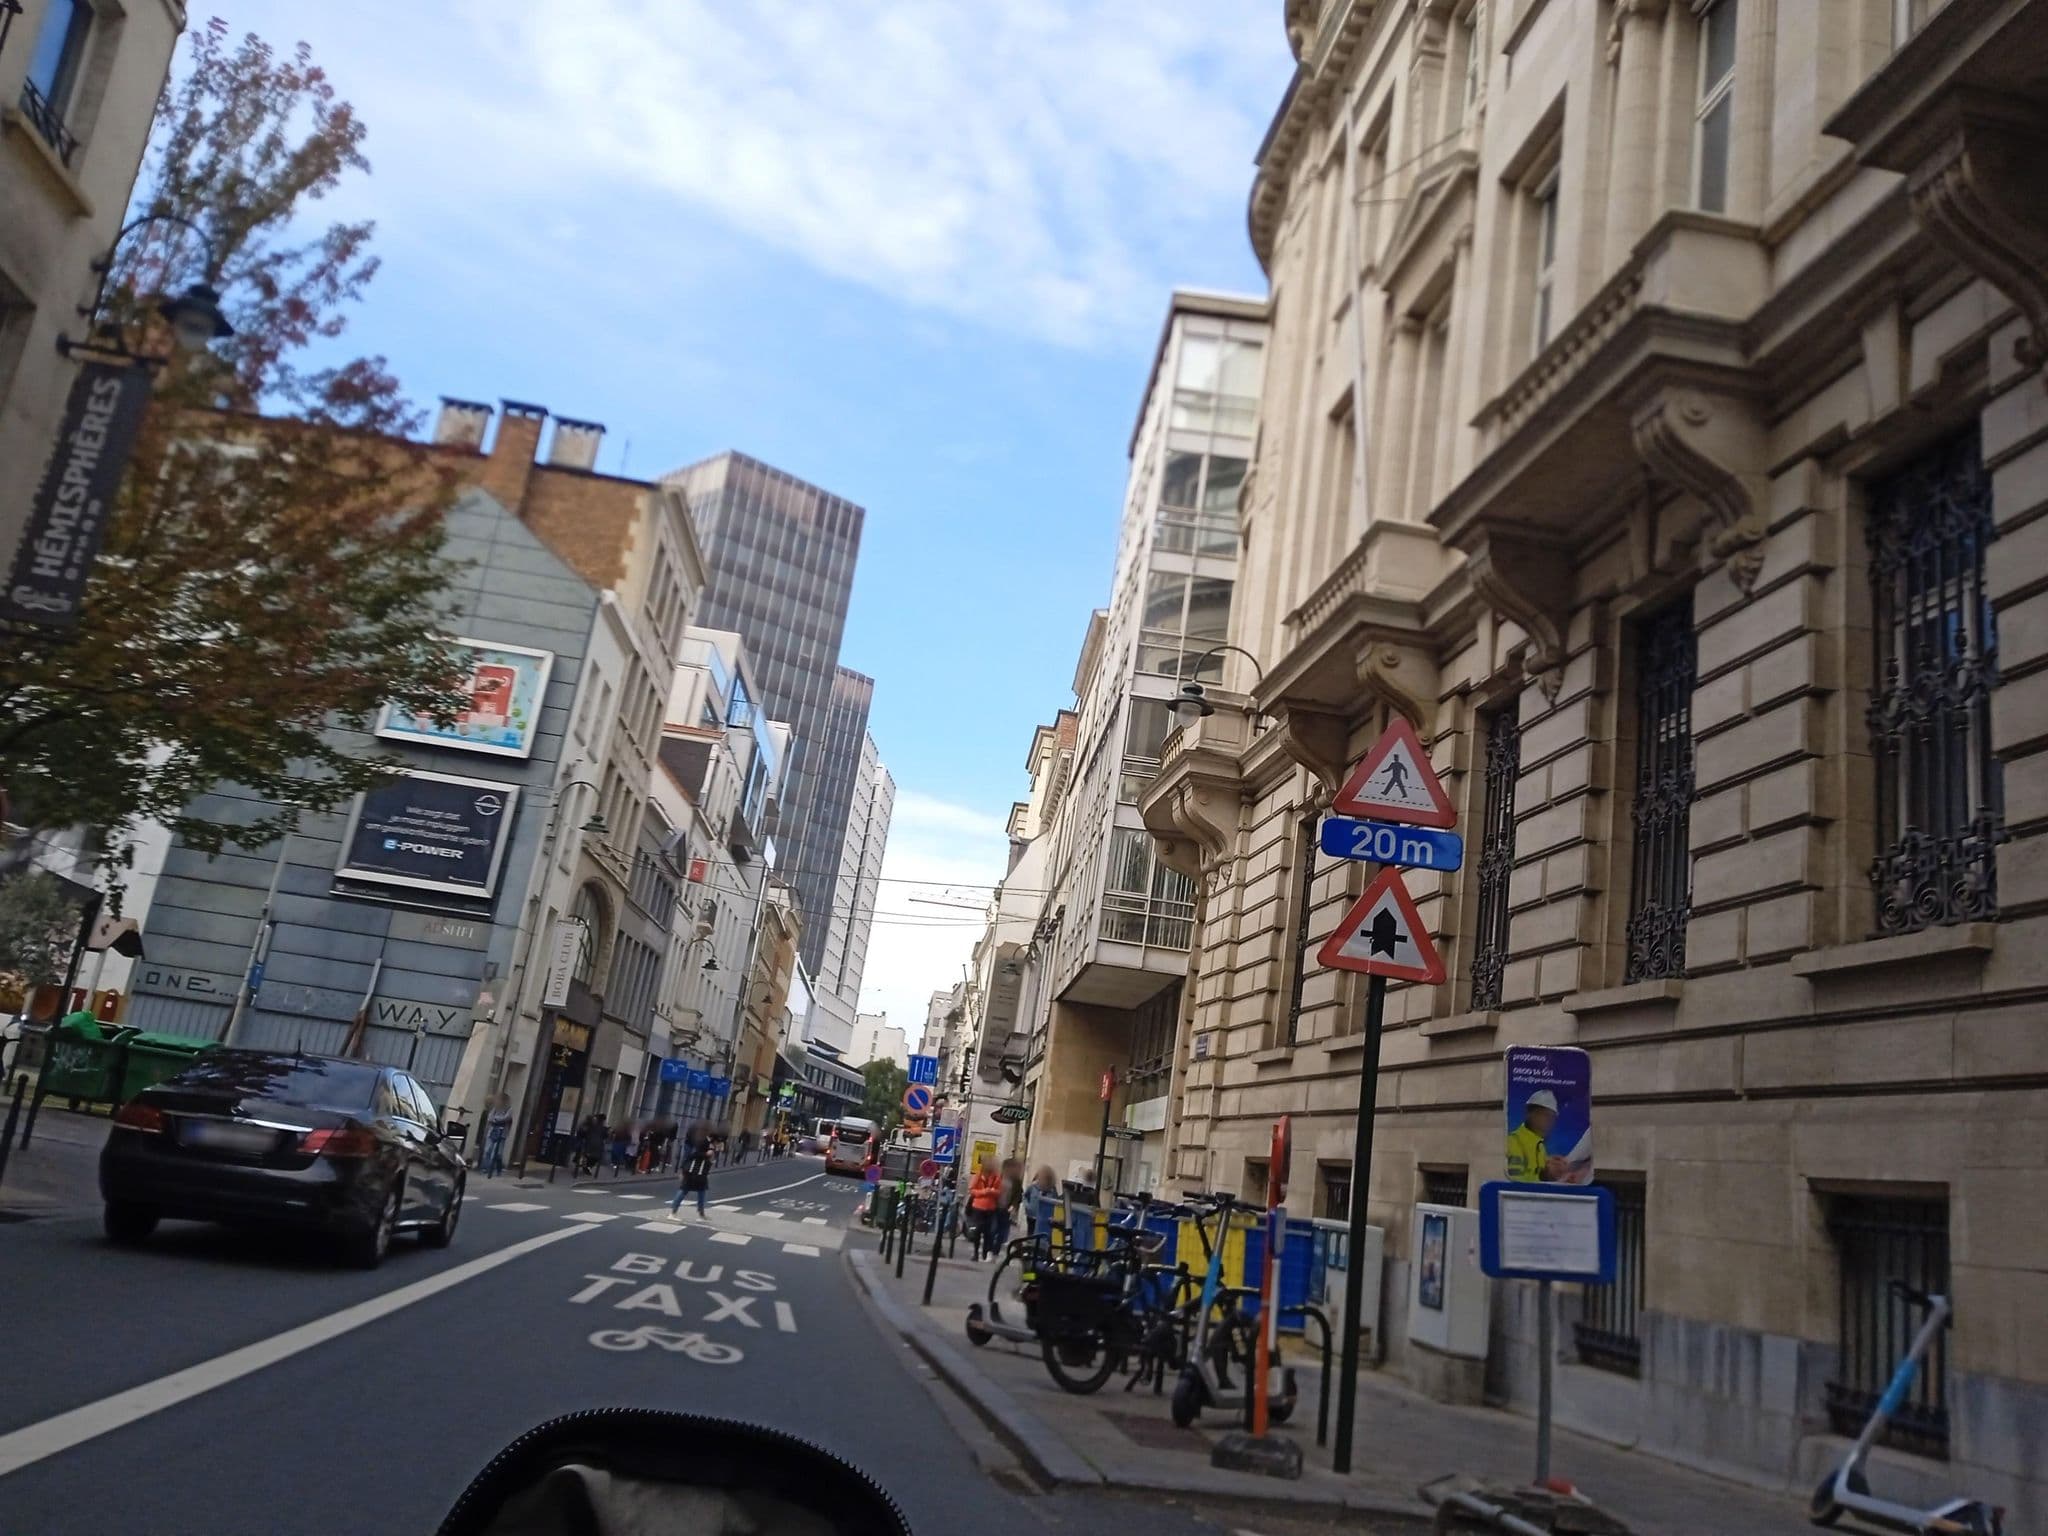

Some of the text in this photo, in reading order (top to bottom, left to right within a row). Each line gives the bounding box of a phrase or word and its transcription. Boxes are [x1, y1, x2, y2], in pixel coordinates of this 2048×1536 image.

[31, 377, 121, 578] HÉMISPHÈRES
[383, 838, 464, 860] e-POWER
[1351, 825, 1433, 864] 20 m
[552, 967, 567, 998] BOBA
[377, 1000, 457, 1031] WAY
[1001, 1107, 1031, 1120] TATTOO
[610, 1252, 778, 1292] BUS
[567, 1273, 799, 1334] TAXI
